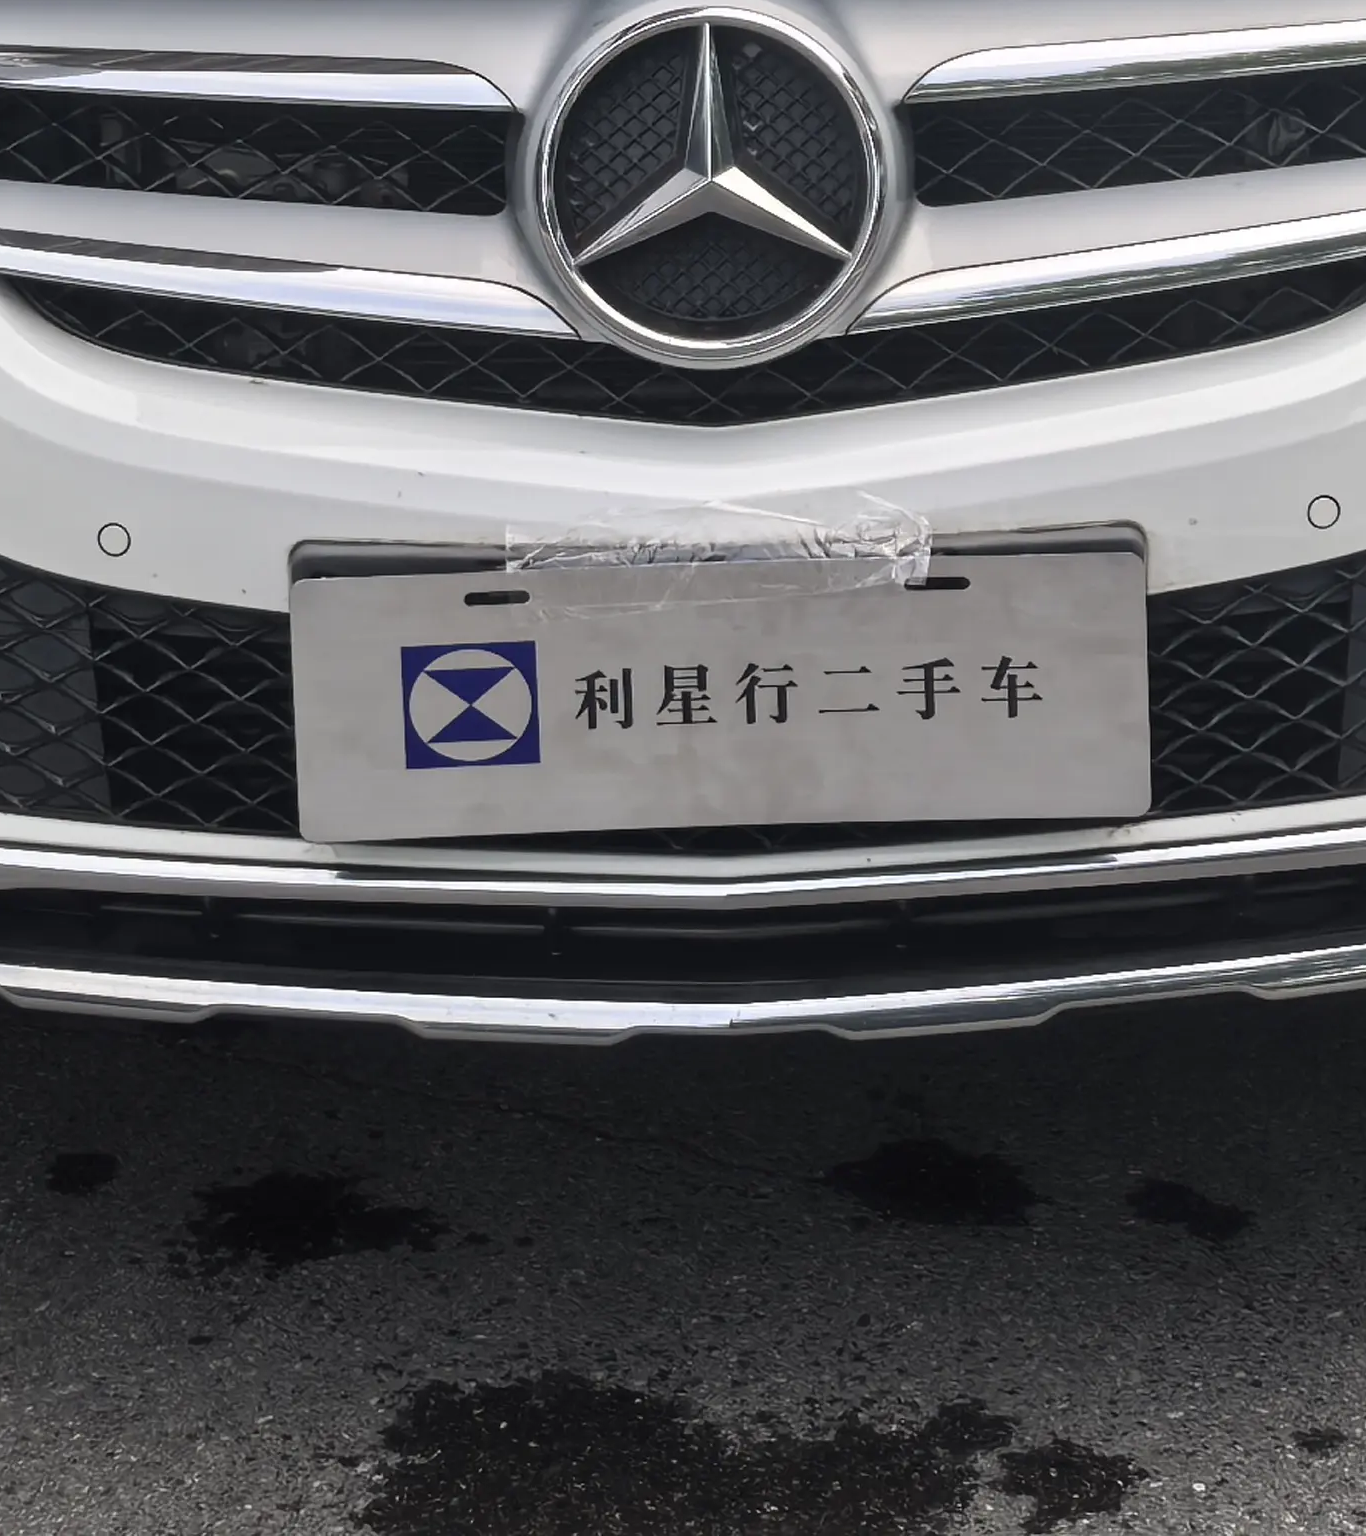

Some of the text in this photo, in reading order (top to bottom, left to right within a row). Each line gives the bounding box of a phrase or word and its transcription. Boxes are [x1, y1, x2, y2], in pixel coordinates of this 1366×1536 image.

[574, 655, 1044, 730] 利星行二手车
